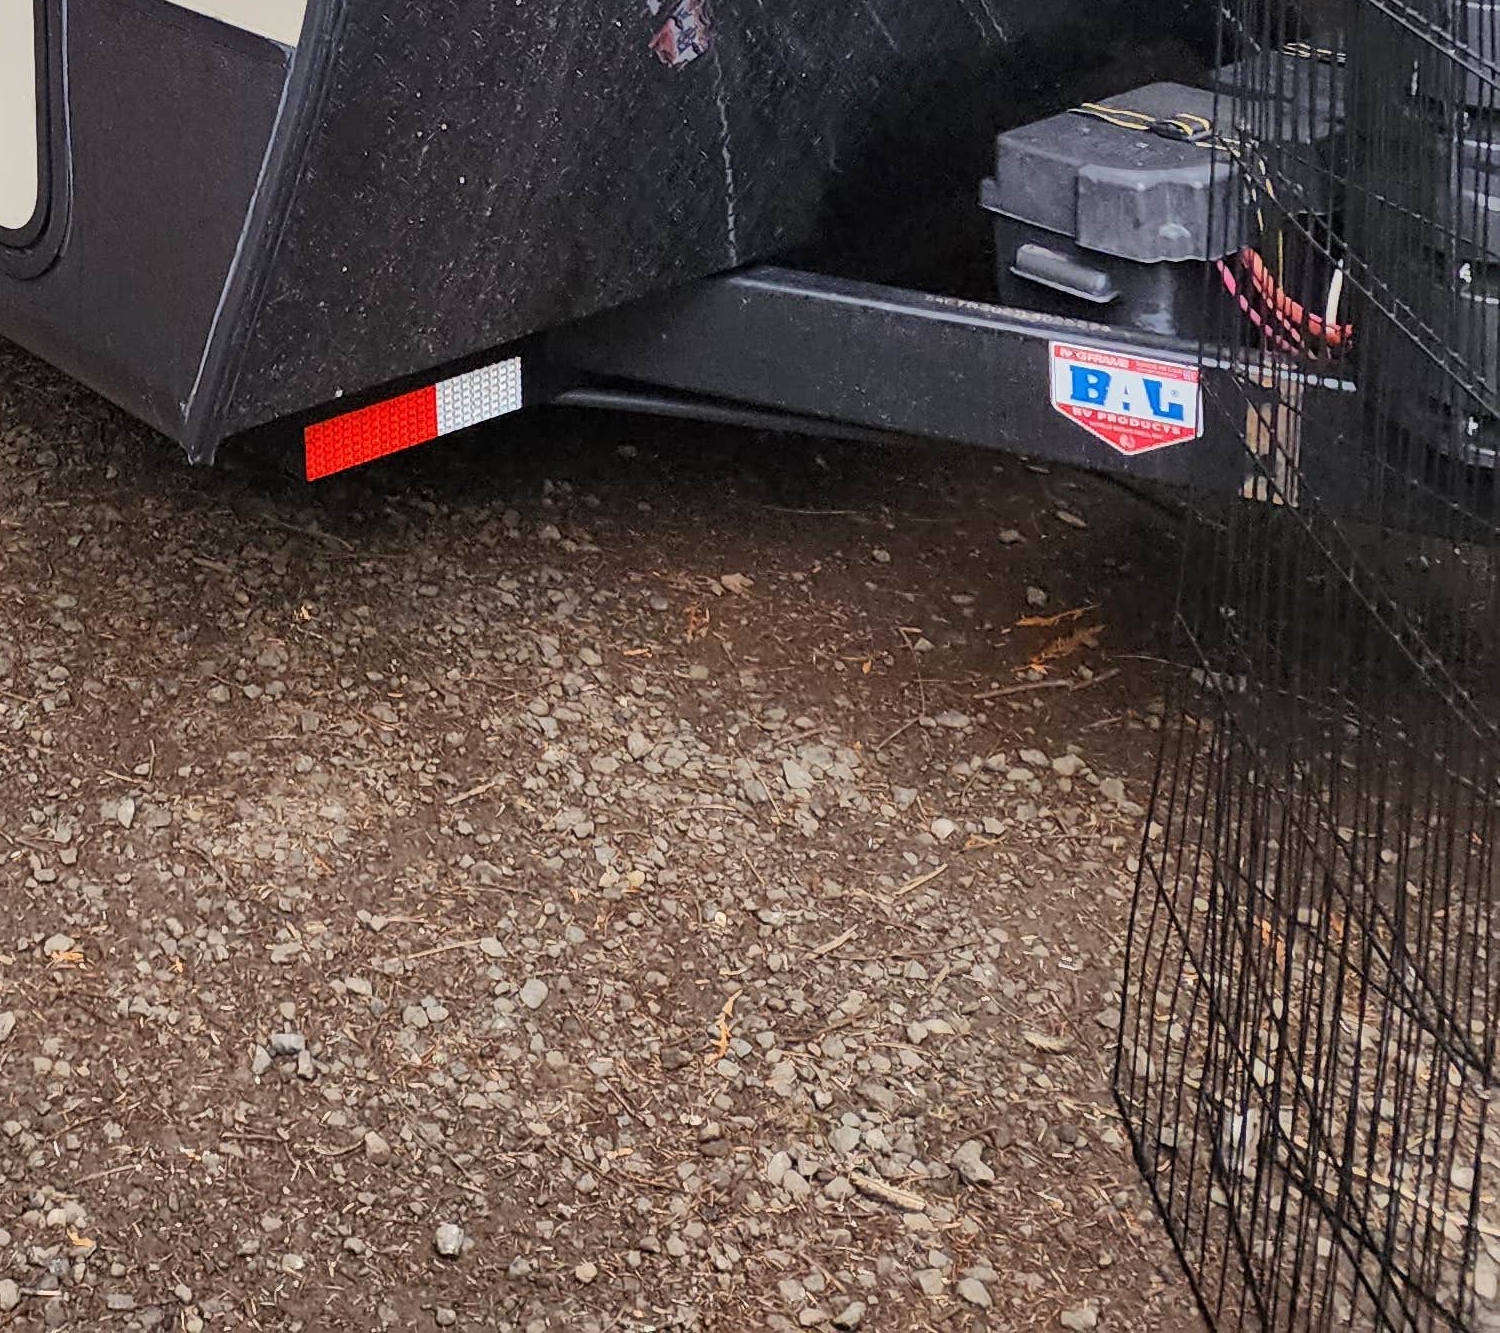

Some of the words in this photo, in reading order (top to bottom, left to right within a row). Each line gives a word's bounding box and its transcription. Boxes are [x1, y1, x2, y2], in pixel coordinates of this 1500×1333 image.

[1069, 364, 1184, 422] BAL
[1072, 405, 1093, 418] RV
[1097, 411, 1181, 435] PRODUCTS
